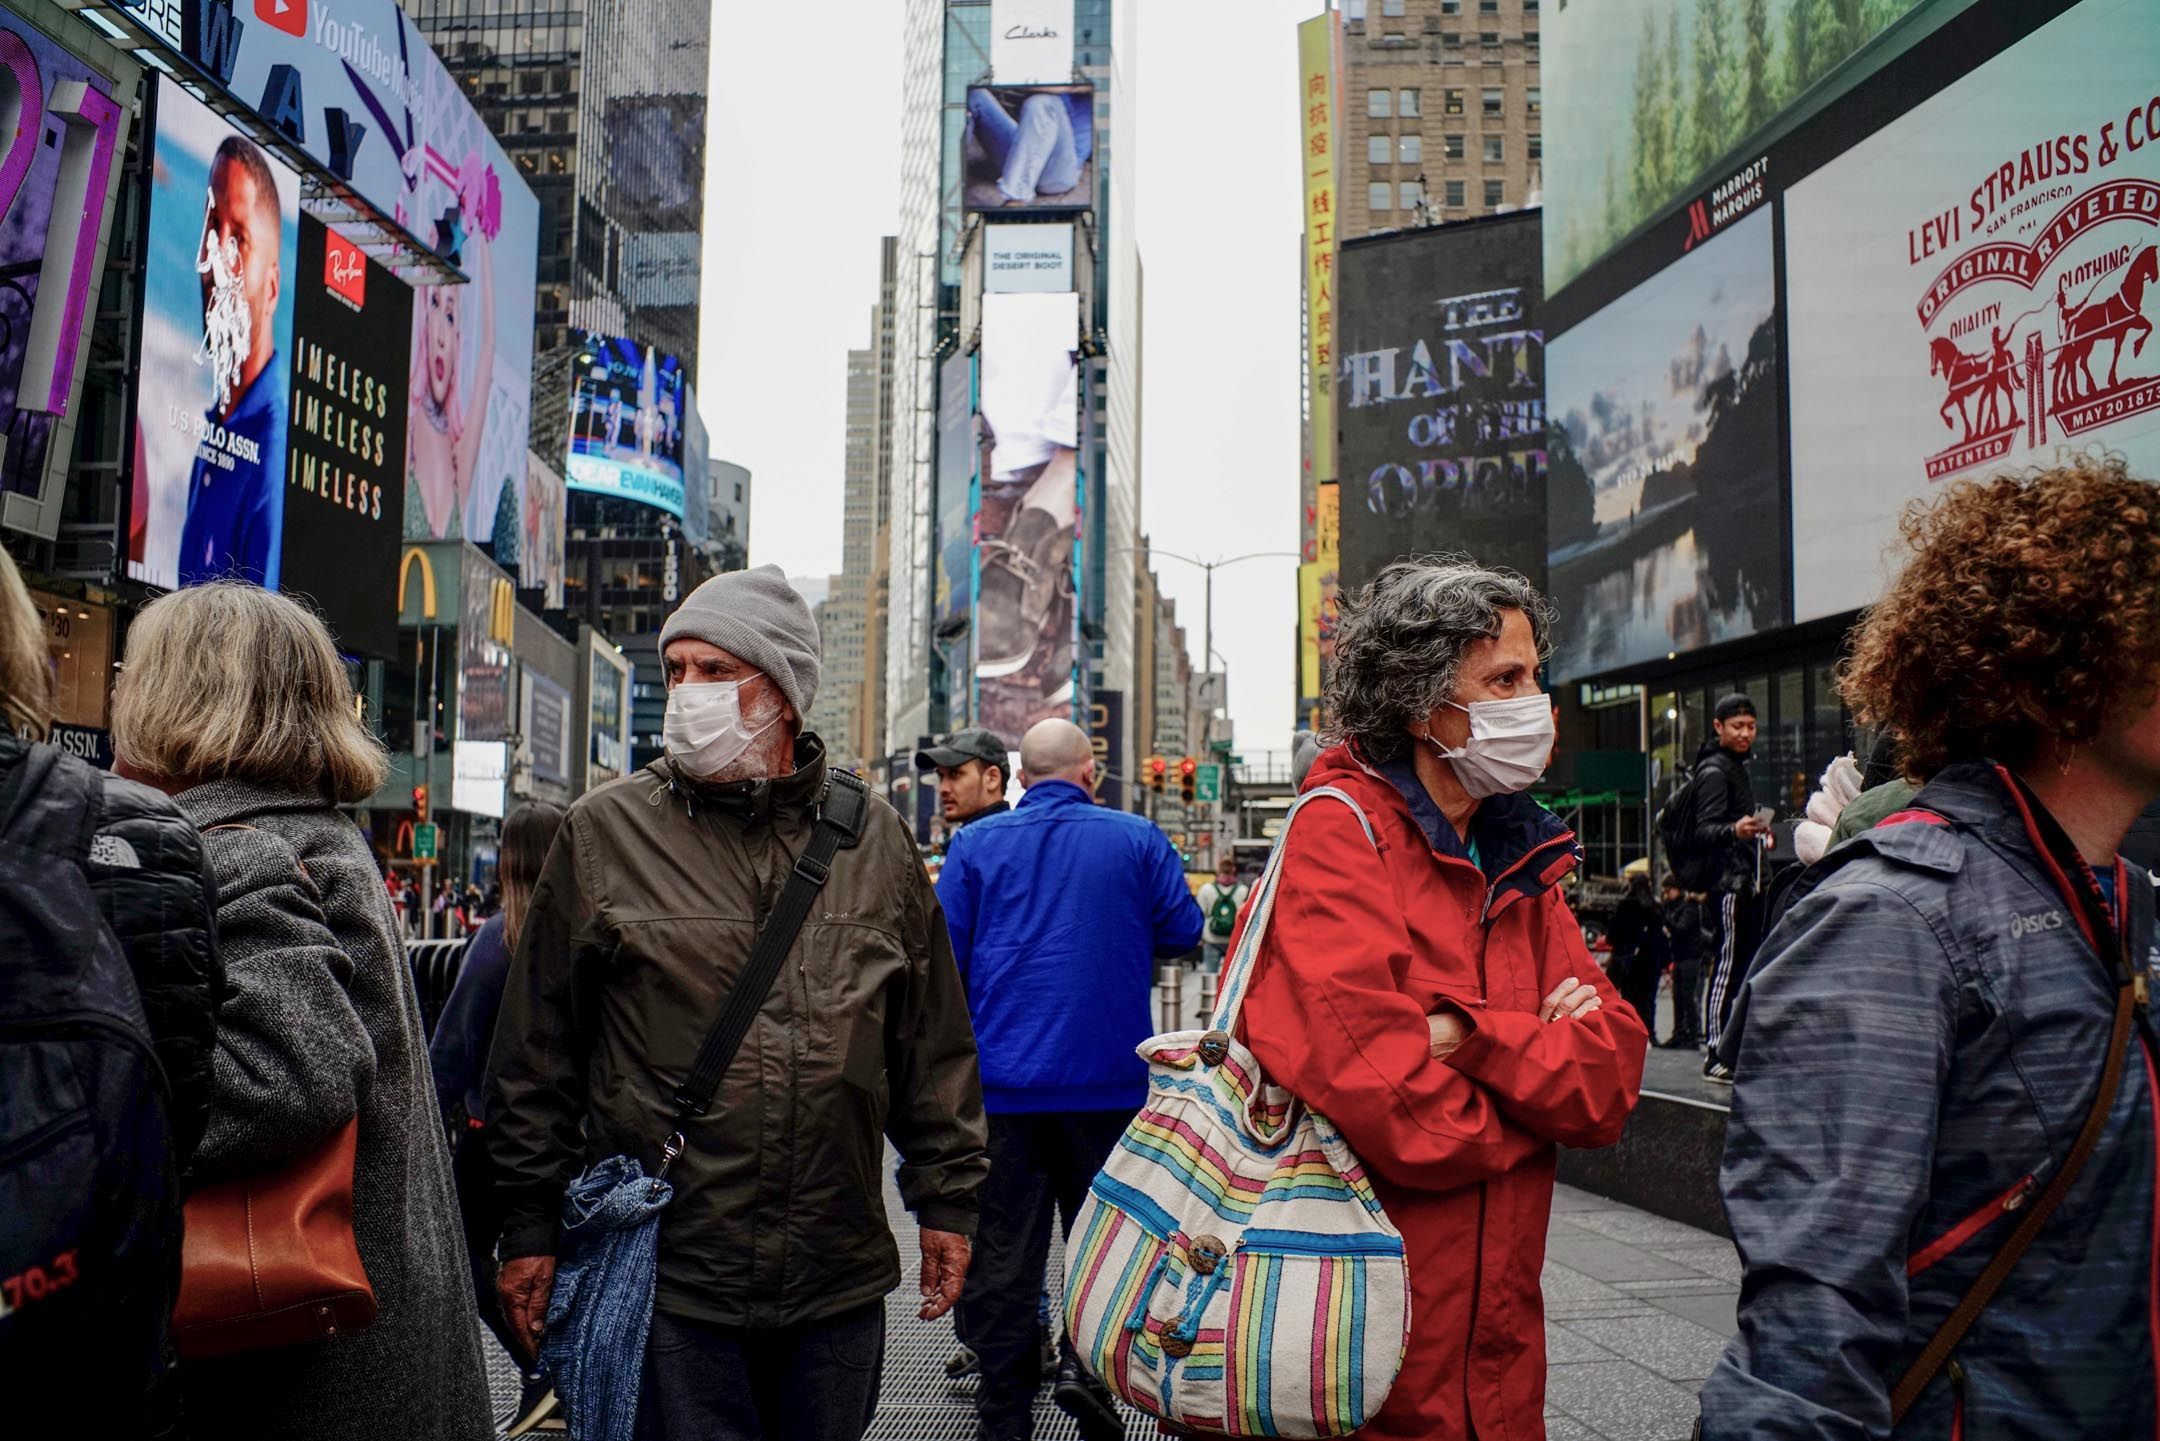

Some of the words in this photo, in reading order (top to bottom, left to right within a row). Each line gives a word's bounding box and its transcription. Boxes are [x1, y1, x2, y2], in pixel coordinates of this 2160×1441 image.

[312, 0, 391, 87] YouTube
[1004, 25, 1057, 40] Clarks
[1712, 155, 1769, 206] MARRIOTT
[1909, 206, 1960, 266] LEVI
[1969, 134, 2089, 233] STRAUSS
[2098, 121, 2119, 168] &
[1712, 183, 1762, 227] MARQUIS
[1986, 214, 2007, 237] SAN
[2010, 185, 2072, 221] FRANCISCO
[993, 252, 1010, 260] THE
[1014, 252, 1062, 260] ORIGINAL
[993, 261, 1031, 270] DESERT
[1034, 261, 1062, 270] BOOT
[1921, 251, 2029, 319] ORIGINAL
[2036, 188, 2158, 264] RIVETED
[2058, 244, 2130, 292] CLOTHING
[1437, 286, 1523, 330] THE
[2072, 406, 2103, 429] MAY
[2106, 400, 2123, 418] 20
[193, 415, 226, 449] POLO
[226, 431, 260, 465] ASSN.
[1929, 439, 2004, 477] PATENTED
[663, 540, 678, 602] 1500
[52, 727, 100, 760] ASSN.
[3, 1249, 79, 1309] 70.3
